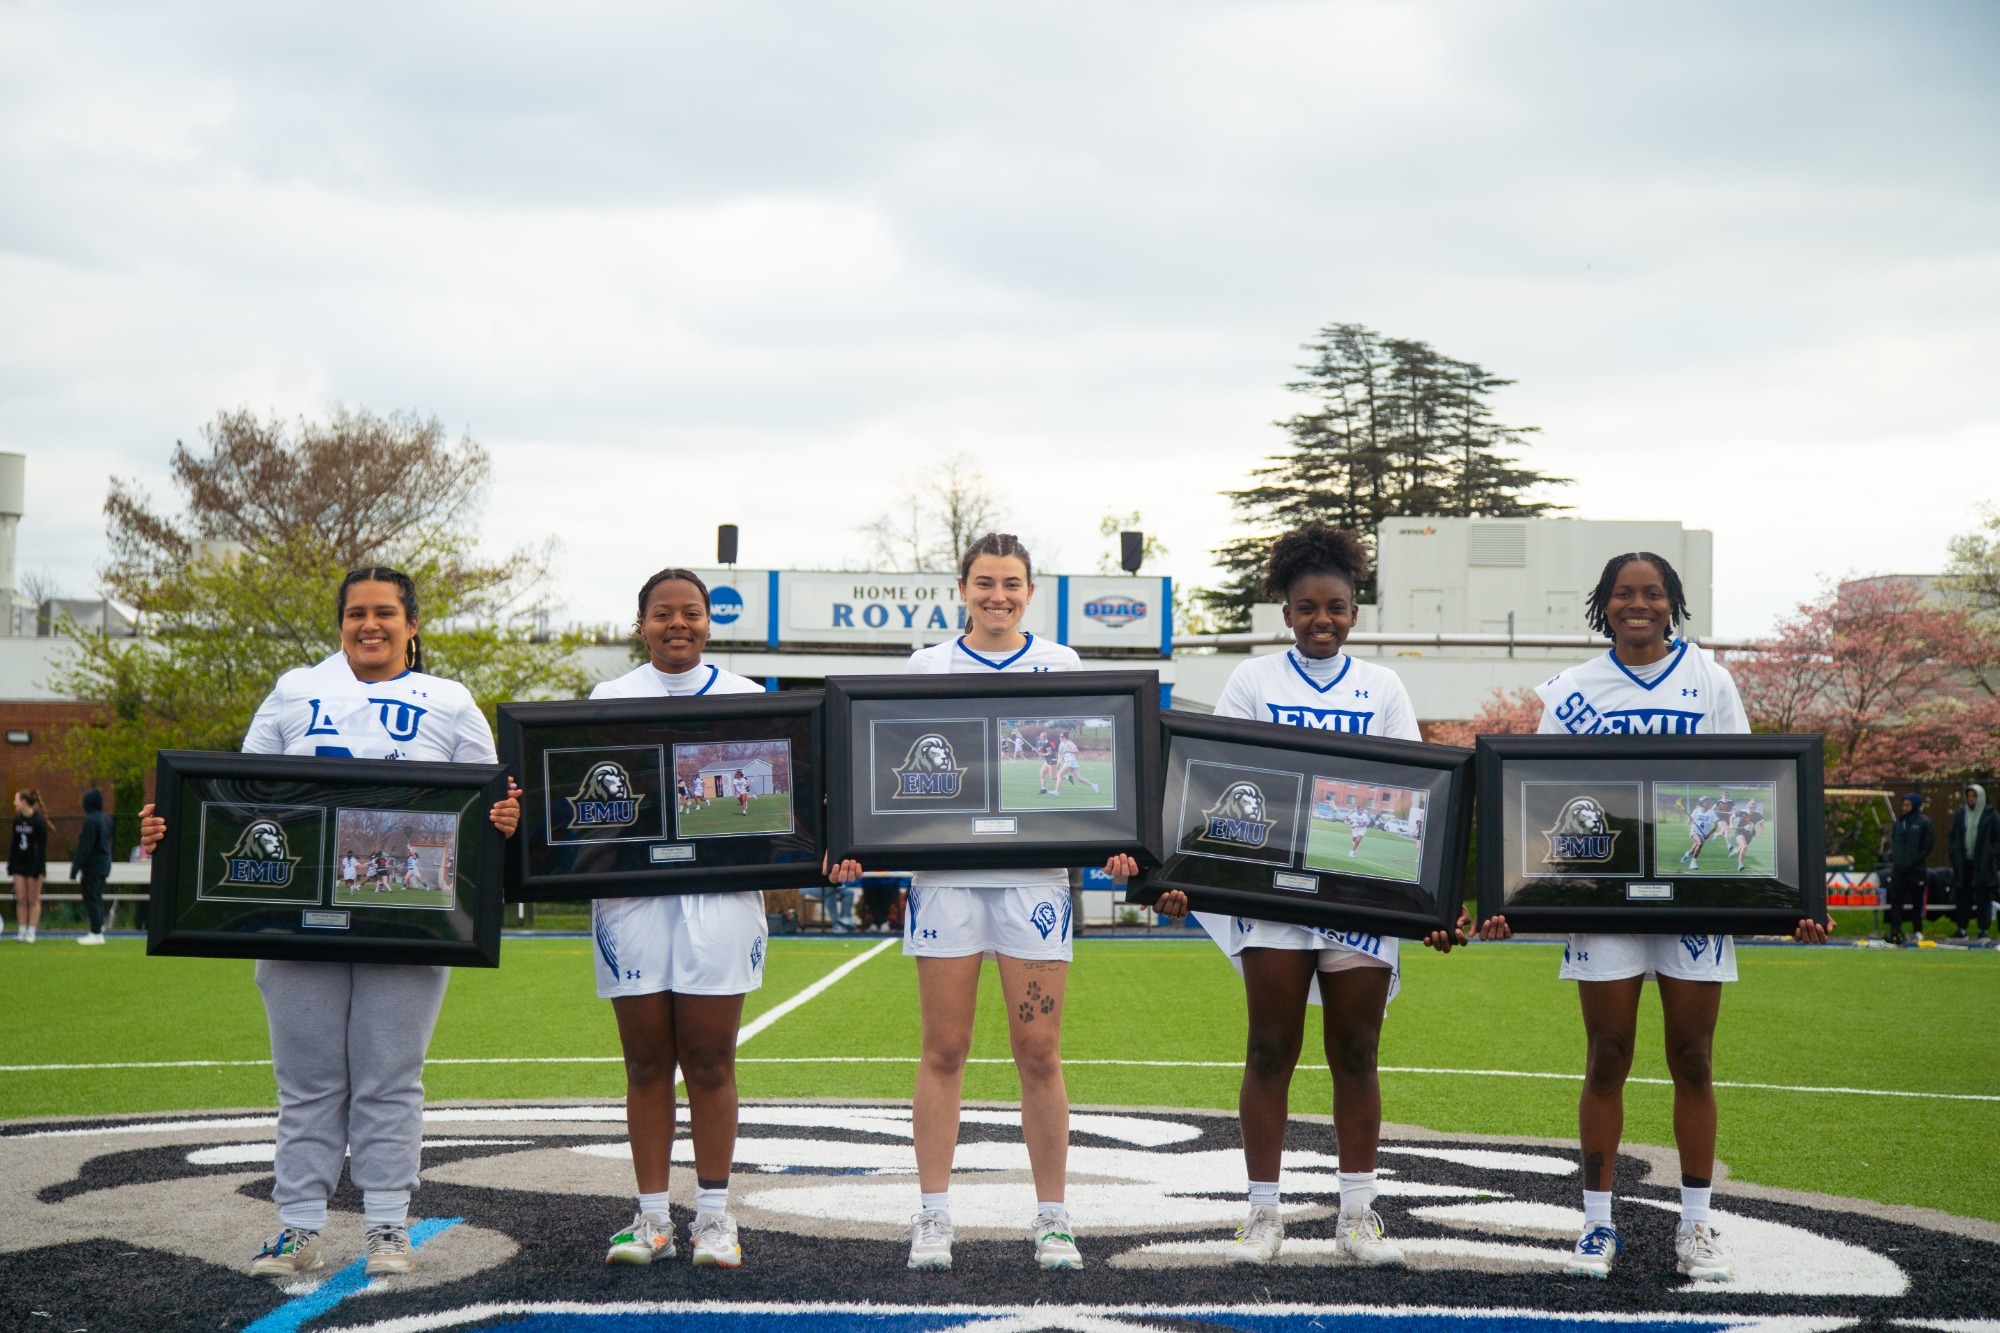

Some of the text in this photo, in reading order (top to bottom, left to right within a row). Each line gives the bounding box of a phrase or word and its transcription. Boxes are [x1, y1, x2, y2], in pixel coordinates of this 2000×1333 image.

[853, 585, 908, 600] HOME
[915, 586, 939, 600] OF
[1083, 601, 1147, 619] ODAC
[902, 772, 958, 795] EMU
[577, 800, 635, 824] EMU
[1208, 816, 1267, 845] EMU
[1552, 836, 1611, 858] EMU
[229, 859, 290, 884] EMU
